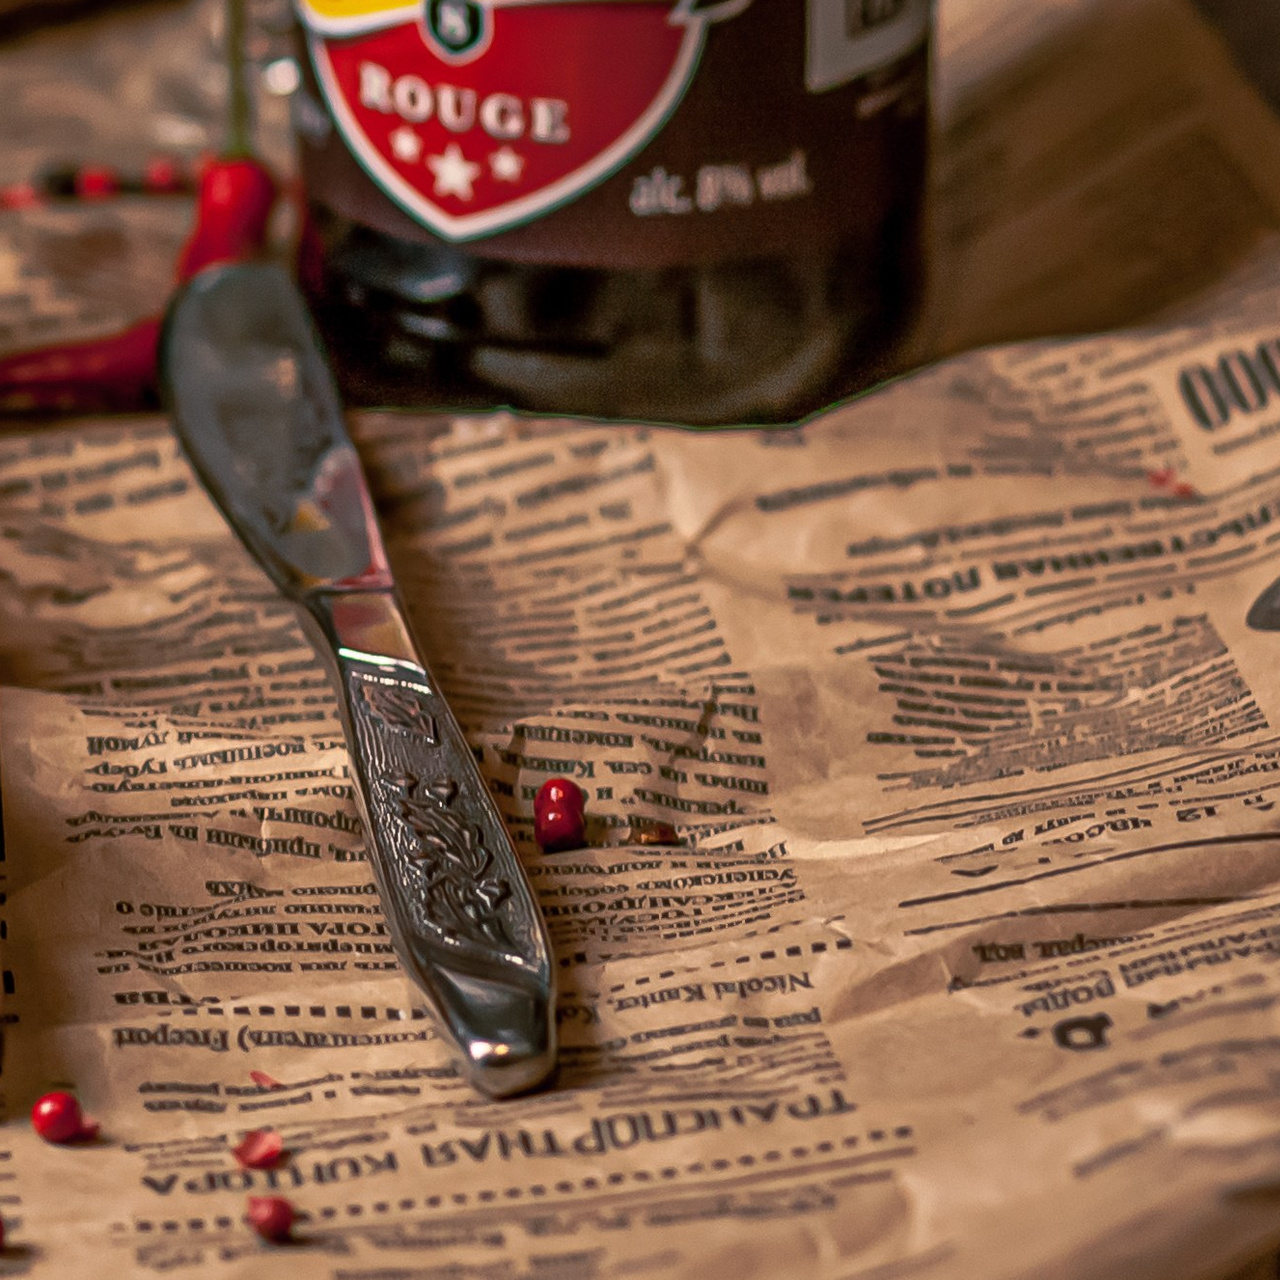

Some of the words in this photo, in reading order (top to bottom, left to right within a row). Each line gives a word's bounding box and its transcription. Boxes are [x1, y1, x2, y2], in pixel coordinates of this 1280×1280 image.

[358, 61, 571, 145] ROUGE
[305, 922, 388, 937] ТОРА
[711, 971, 814, 1000] Nicolai
[112, 1023, 230, 1053] Freeport
